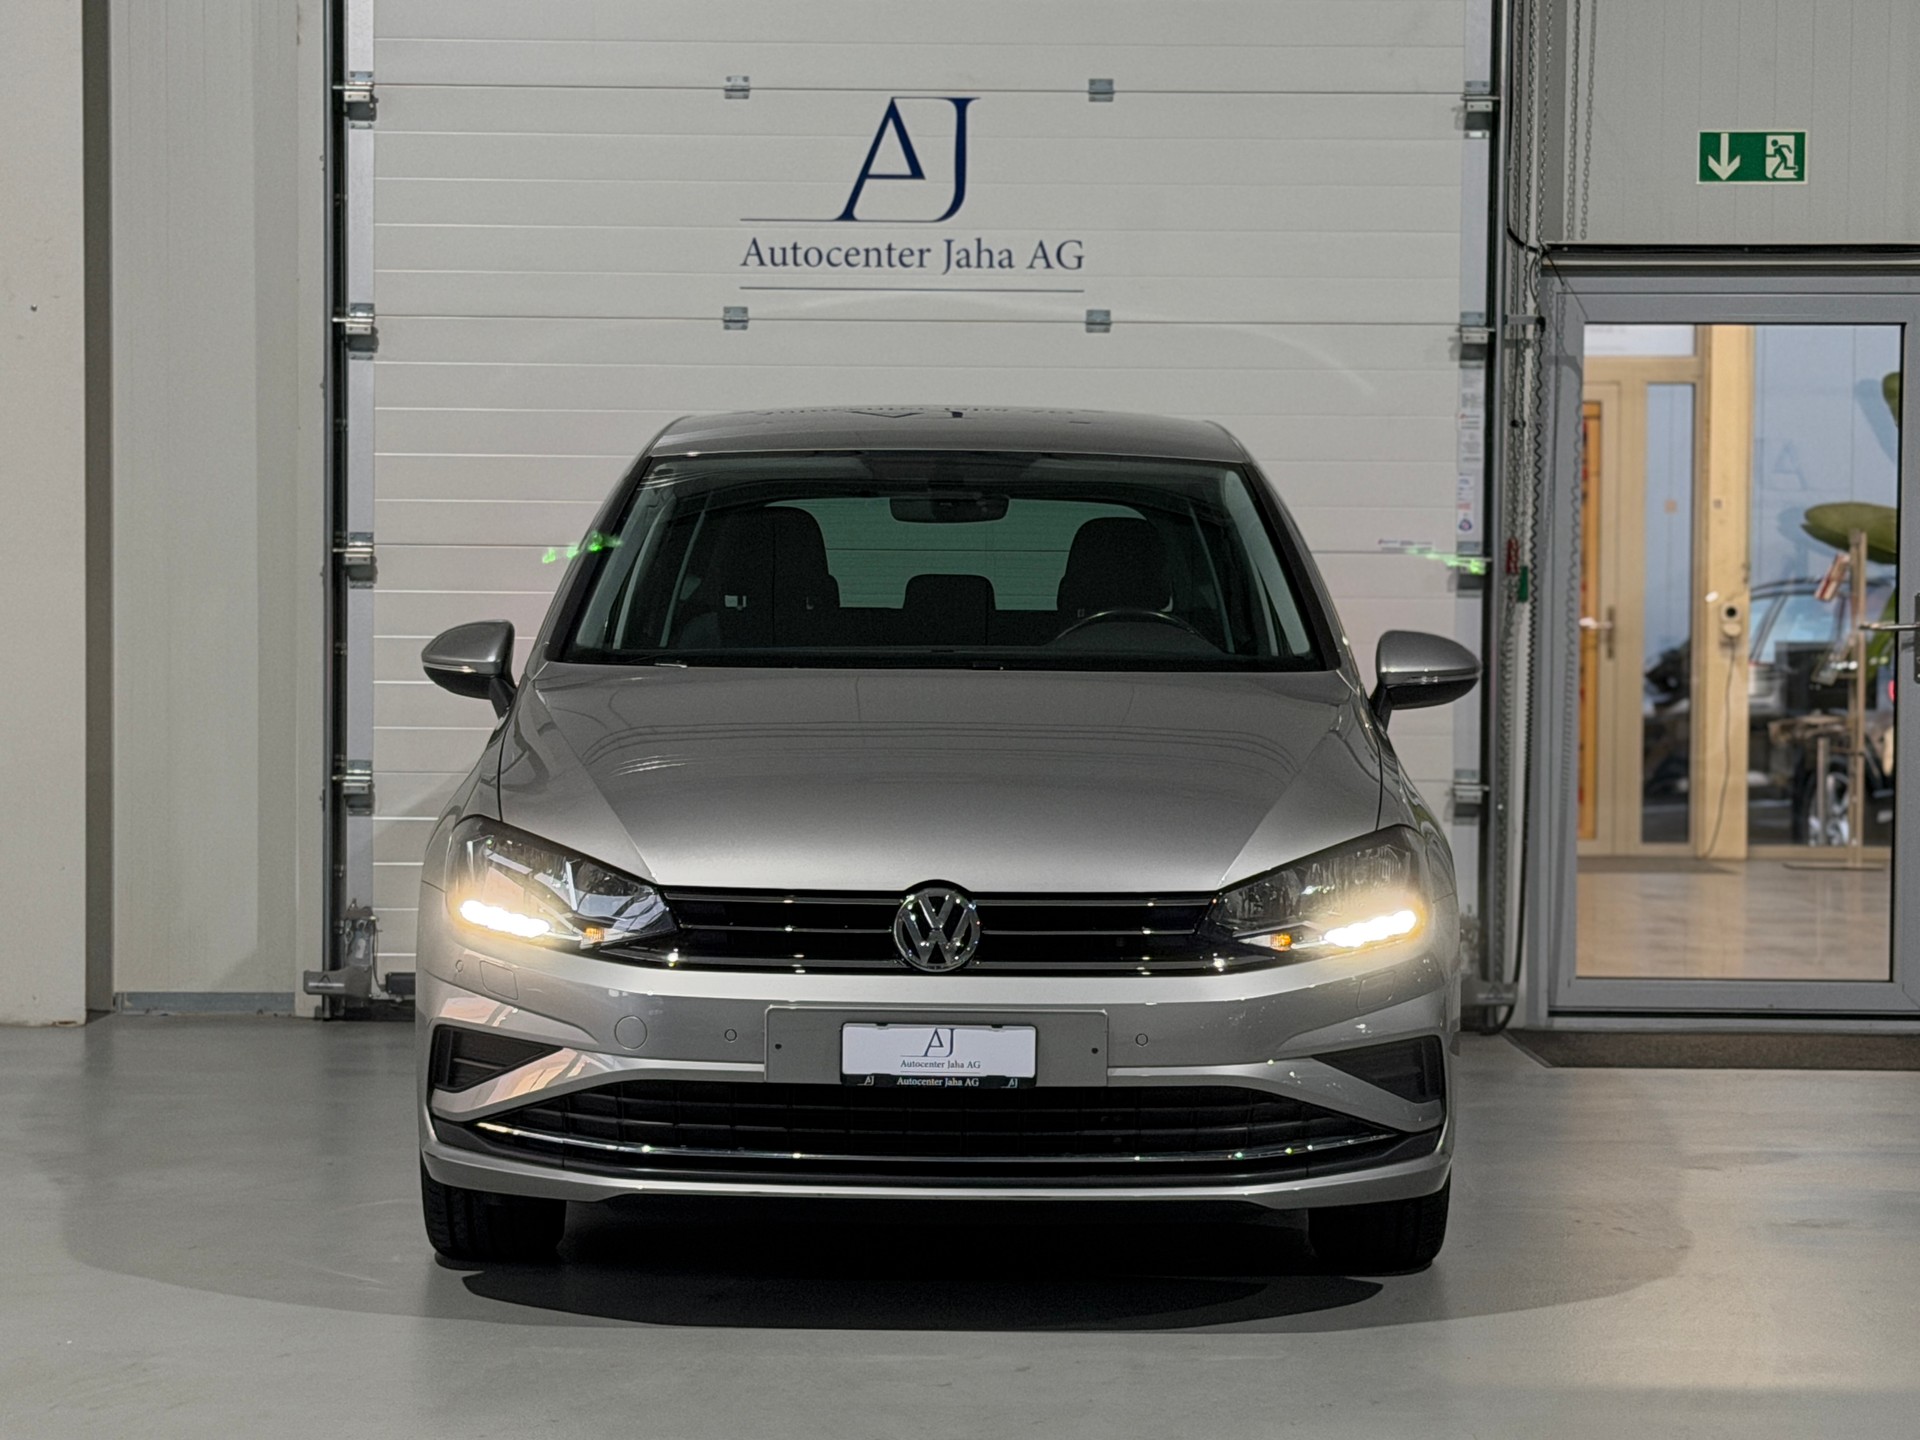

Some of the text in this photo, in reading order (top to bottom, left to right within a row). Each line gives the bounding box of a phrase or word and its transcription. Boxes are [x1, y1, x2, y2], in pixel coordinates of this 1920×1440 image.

[832, 96, 981, 223] AJ
[740, 237, 1085, 275] Autocenter Jaha AG
[899, 890, 977, 967] VW
[922, 1028, 957, 1058] AJ
[900, 1059, 981, 1069] Autocenter Jaha AG
[896, 1076, 980, 1087] Autocenter Jaha AG
